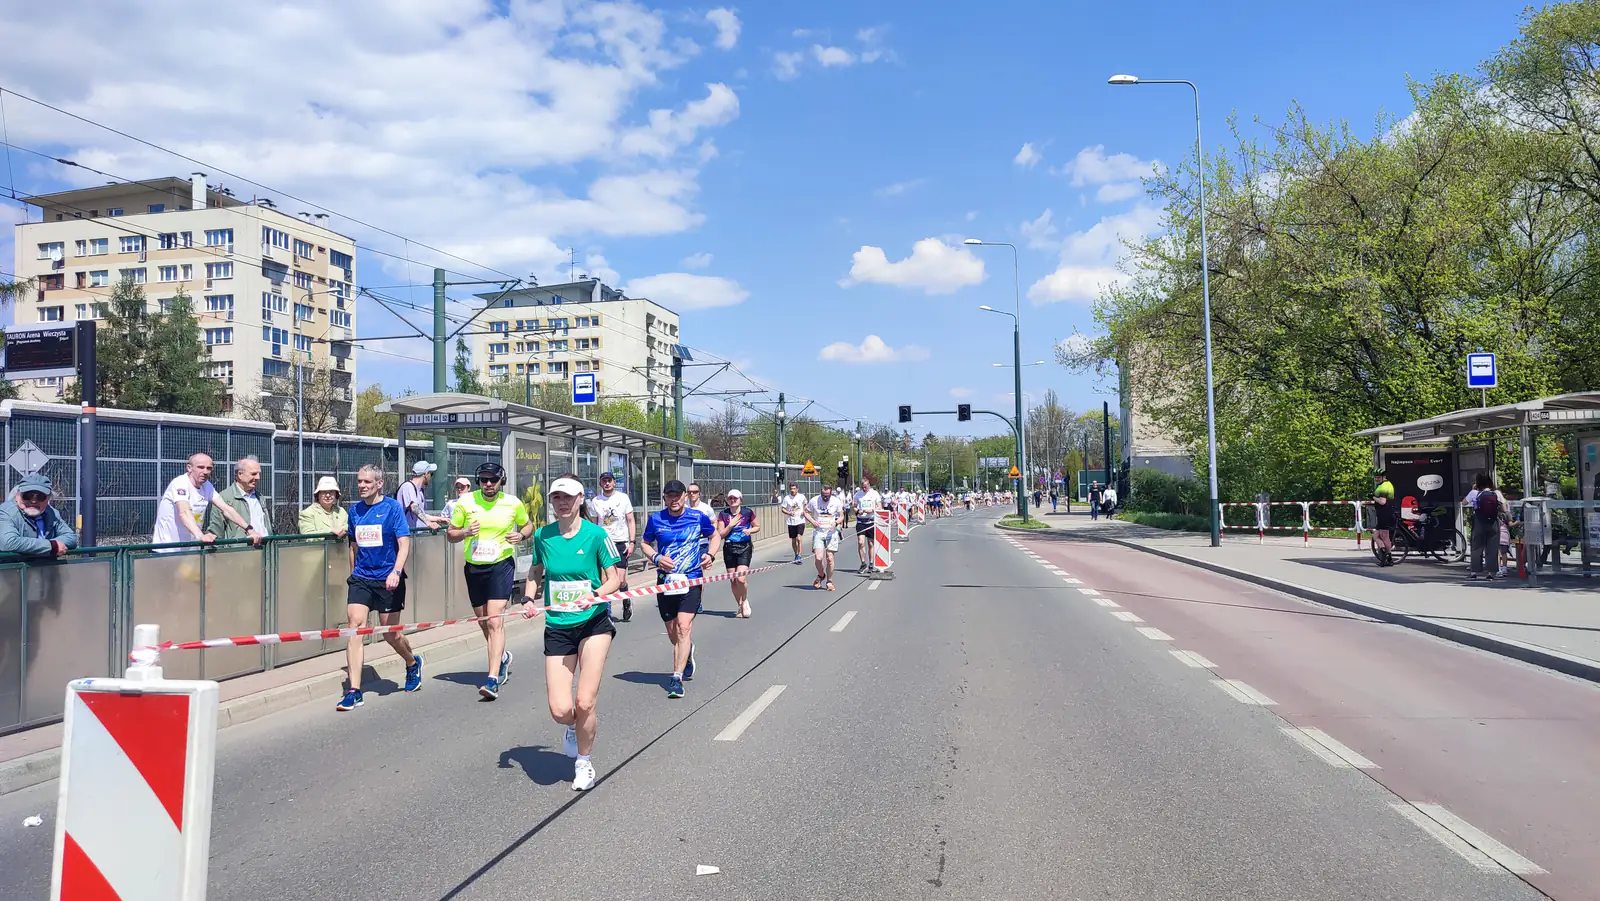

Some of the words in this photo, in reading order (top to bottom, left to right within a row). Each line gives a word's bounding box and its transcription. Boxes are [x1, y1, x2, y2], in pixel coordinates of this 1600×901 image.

[7, 332, 26, 340] TAURON
[43, 330, 67, 338] Wieczysta
[557, 591, 582, 601] 4872
